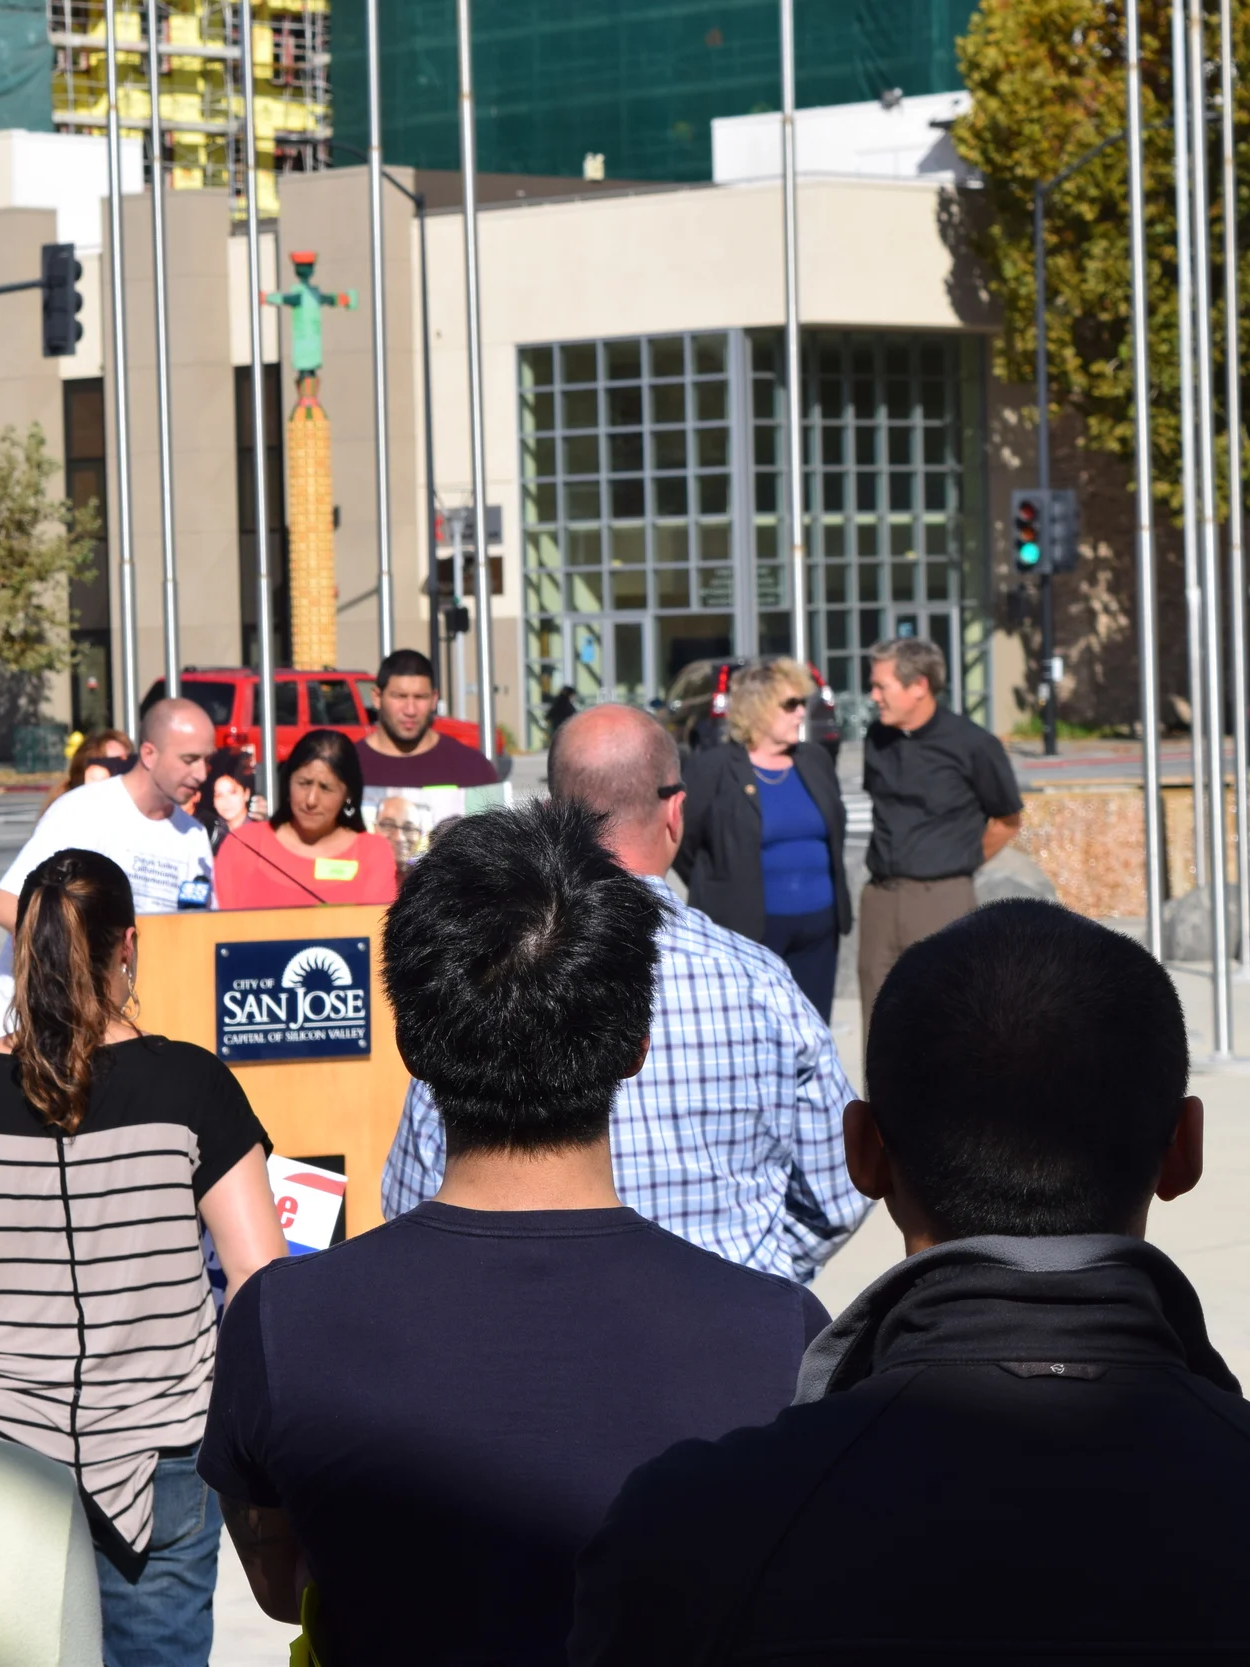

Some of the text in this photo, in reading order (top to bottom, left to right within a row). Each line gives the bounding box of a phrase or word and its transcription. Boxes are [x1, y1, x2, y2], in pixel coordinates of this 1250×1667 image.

[232, 978, 275, 990] CITY OF
[223, 986, 366, 1030] SAN JOSE
[223, 1027, 366, 1045] CAPITAL OF SILICON VALLEY
